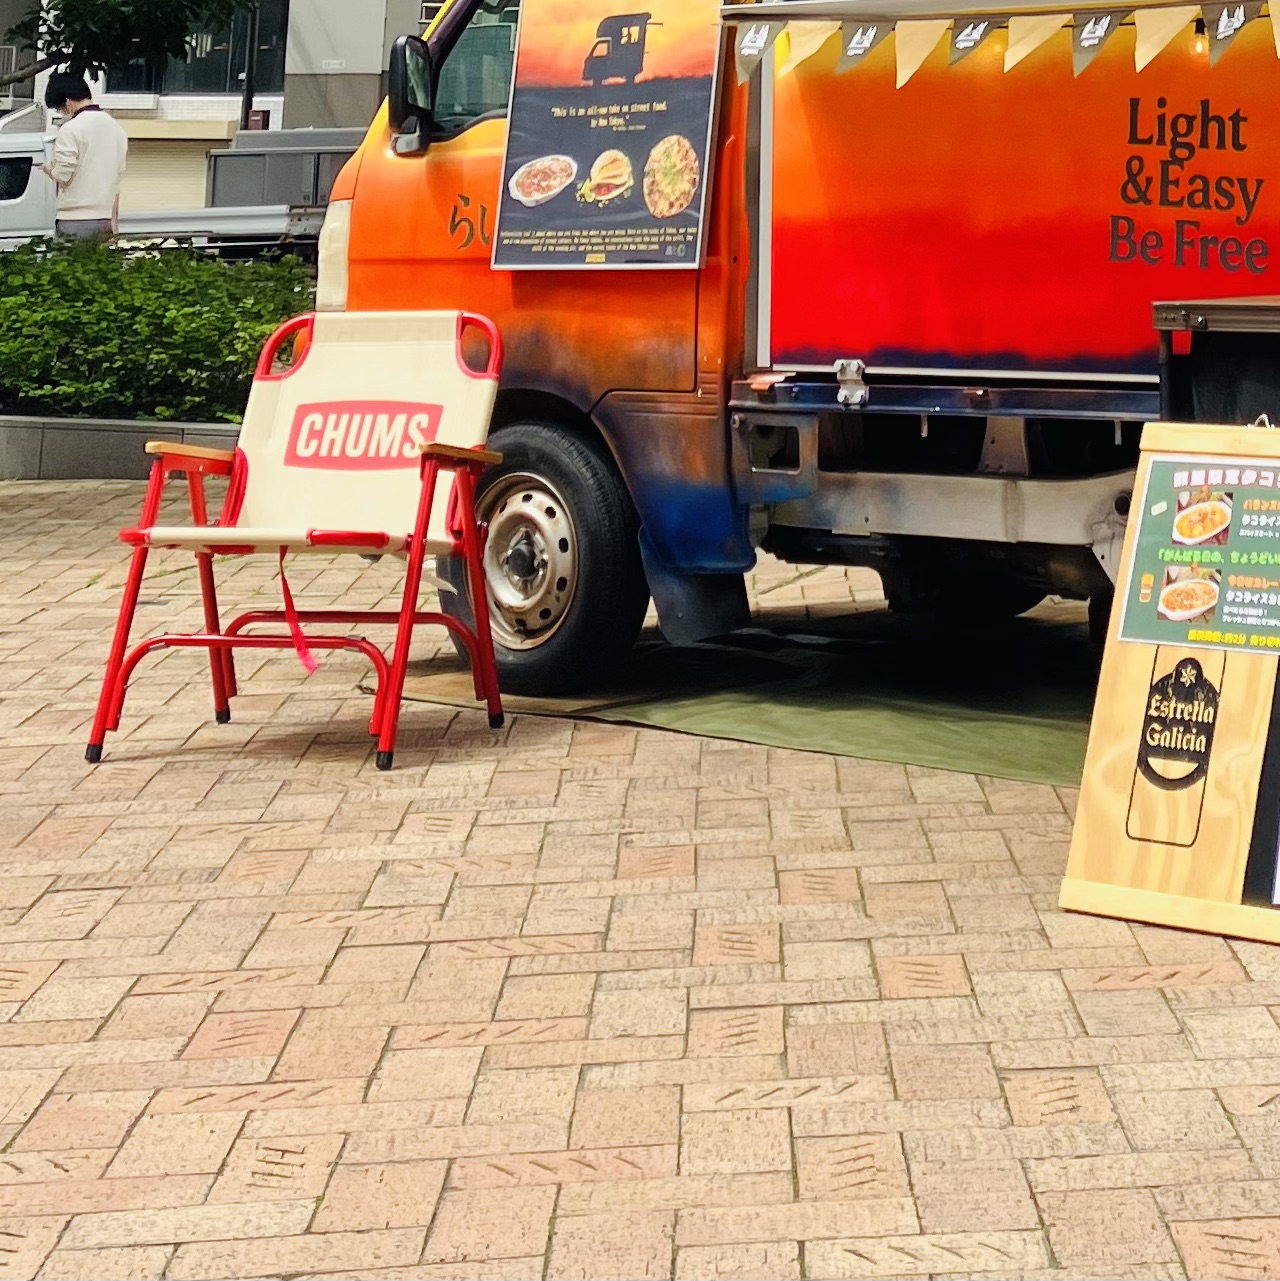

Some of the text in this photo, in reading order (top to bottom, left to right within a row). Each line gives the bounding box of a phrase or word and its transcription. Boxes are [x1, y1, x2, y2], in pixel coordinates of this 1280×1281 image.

[1127, 97, 1248, 162] Light
[1120, 155, 1264, 225] &Easy
[1109, 216, 1268, 275] Be Free
[296, 413, 429, 458] CHUMS
[1148, 693, 1215, 724] Estrella
[1146, 722, 1207, 753] Galicia
